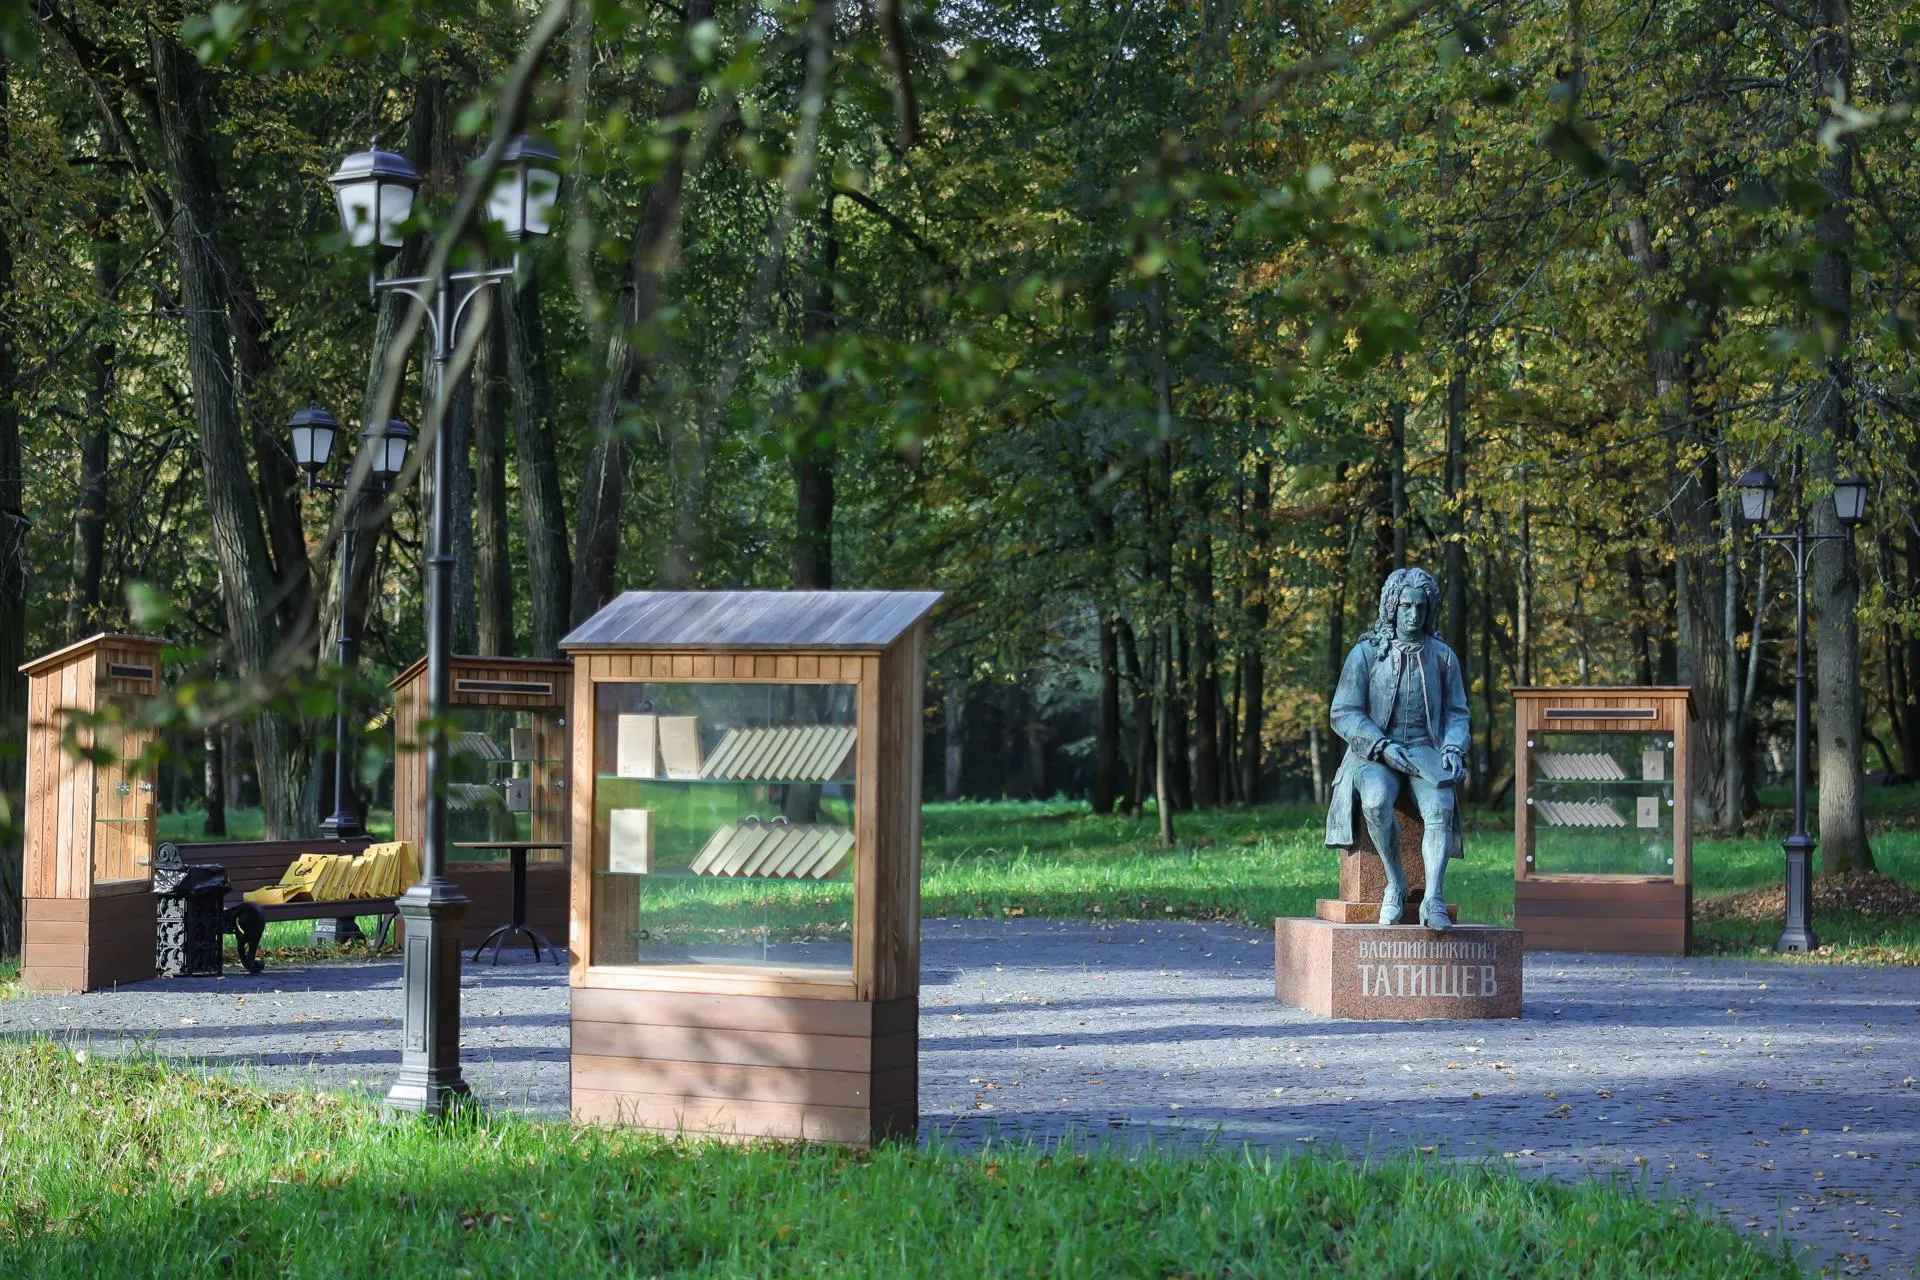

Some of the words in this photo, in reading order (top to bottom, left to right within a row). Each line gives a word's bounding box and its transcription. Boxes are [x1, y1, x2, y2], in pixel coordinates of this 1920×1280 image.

[1359, 939, 1427, 959] ВАСИЛИЙ
[1430, 941, 1497, 960] НИКИТИЧ
[1358, 964, 1498, 998] ТАТИЩЕВ
